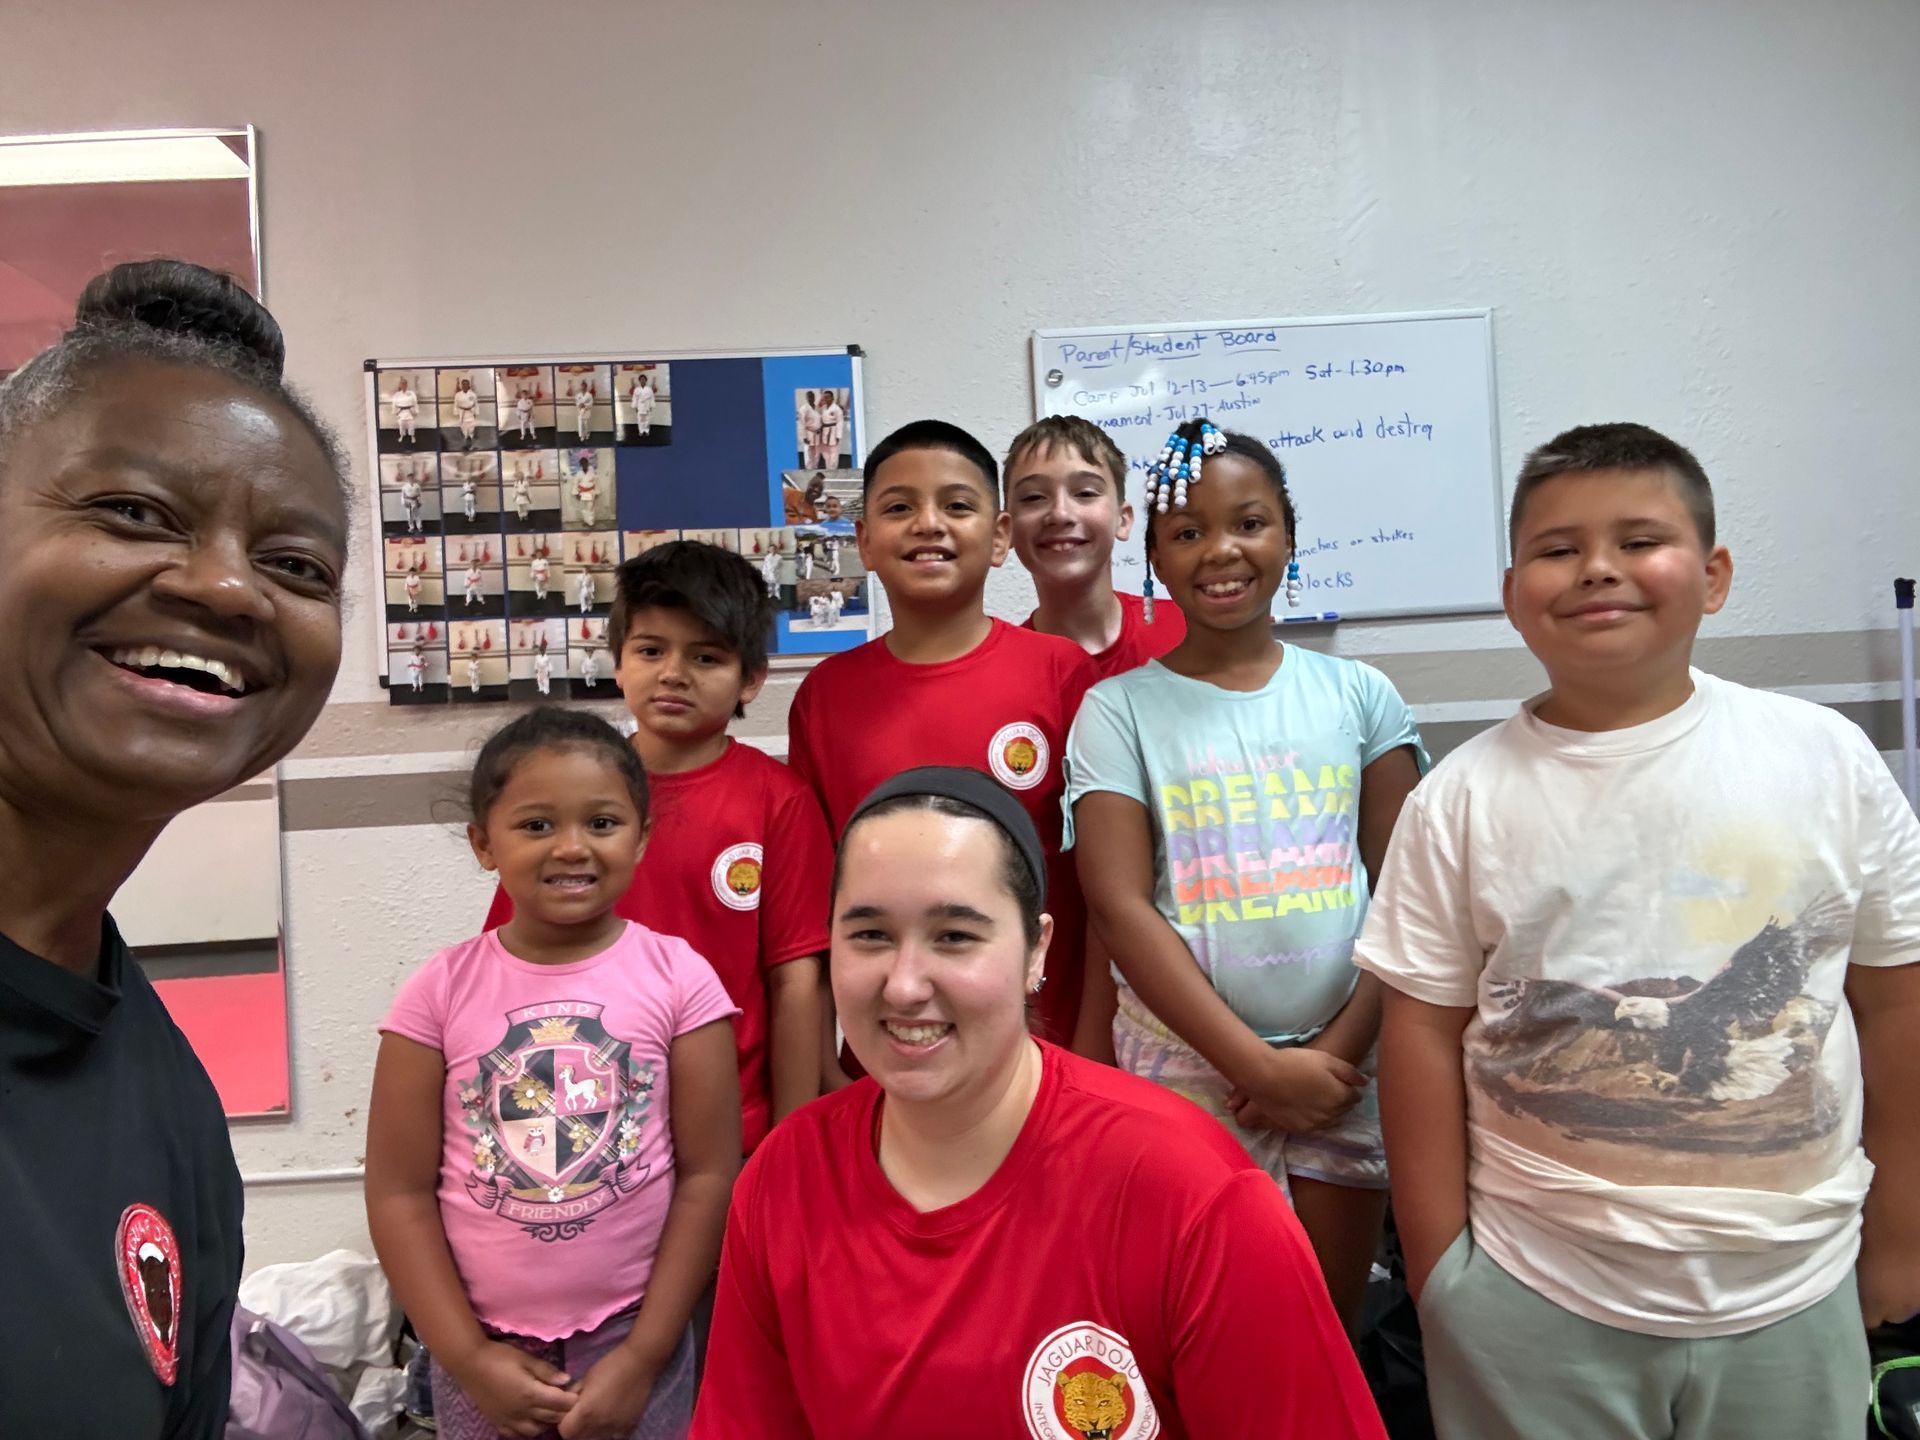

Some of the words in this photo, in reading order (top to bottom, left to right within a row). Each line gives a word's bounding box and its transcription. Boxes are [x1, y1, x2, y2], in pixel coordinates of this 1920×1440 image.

[1215, 330, 1277, 347] Board
[1073, 390, 1119, 407] Camp
[1268, 425, 1326, 449] attack
[1375, 412, 1433, 441] destroy
[1294, 537, 1339, 559] unches
[522, 1002, 592, 1018] KIND
[507, 1194, 608, 1221] FRIENDLY
[1037, 1335, 1094, 1388] JAGUAR
[1096, 1339, 1140, 1380] DOJO
